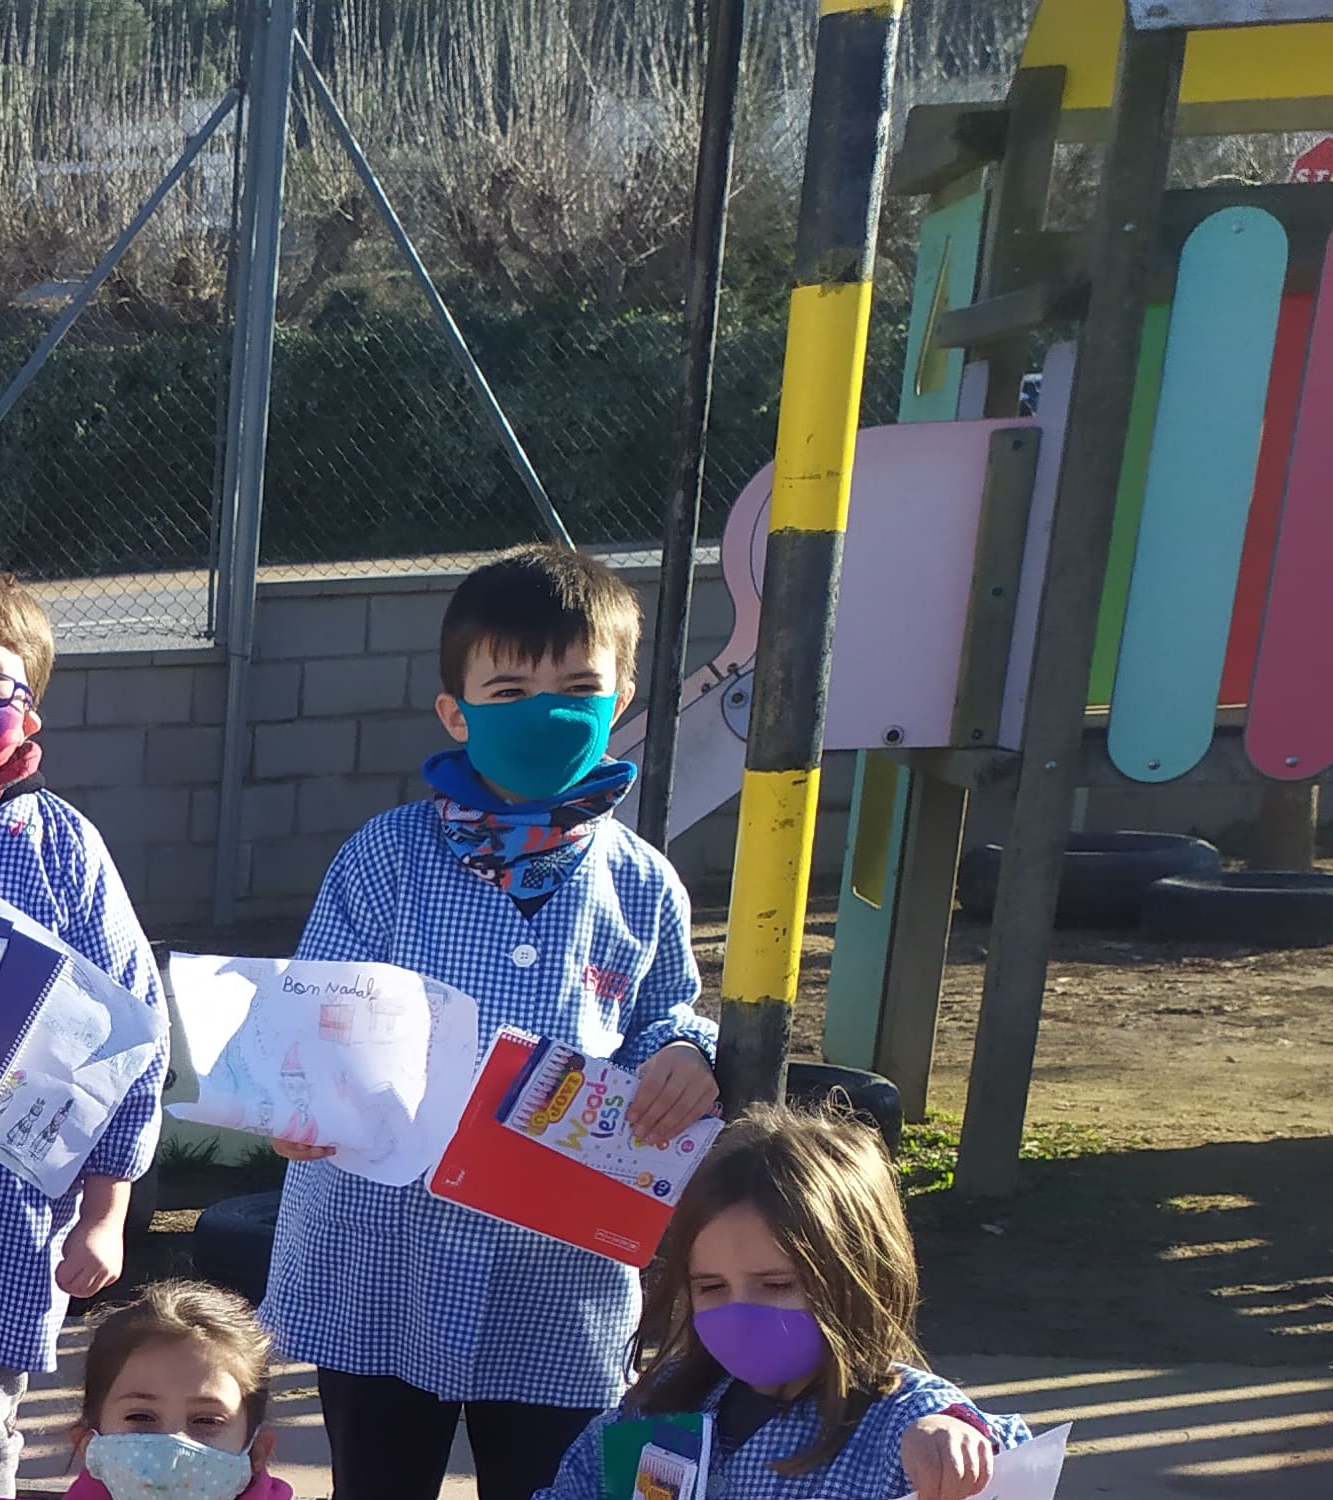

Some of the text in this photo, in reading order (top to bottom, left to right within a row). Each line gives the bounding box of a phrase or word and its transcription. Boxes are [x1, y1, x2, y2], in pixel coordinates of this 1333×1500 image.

[282, 975, 321, 996] Bon
[551, 1074, 581, 1118] JOVI
[590, 1094, 625, 1139] less
